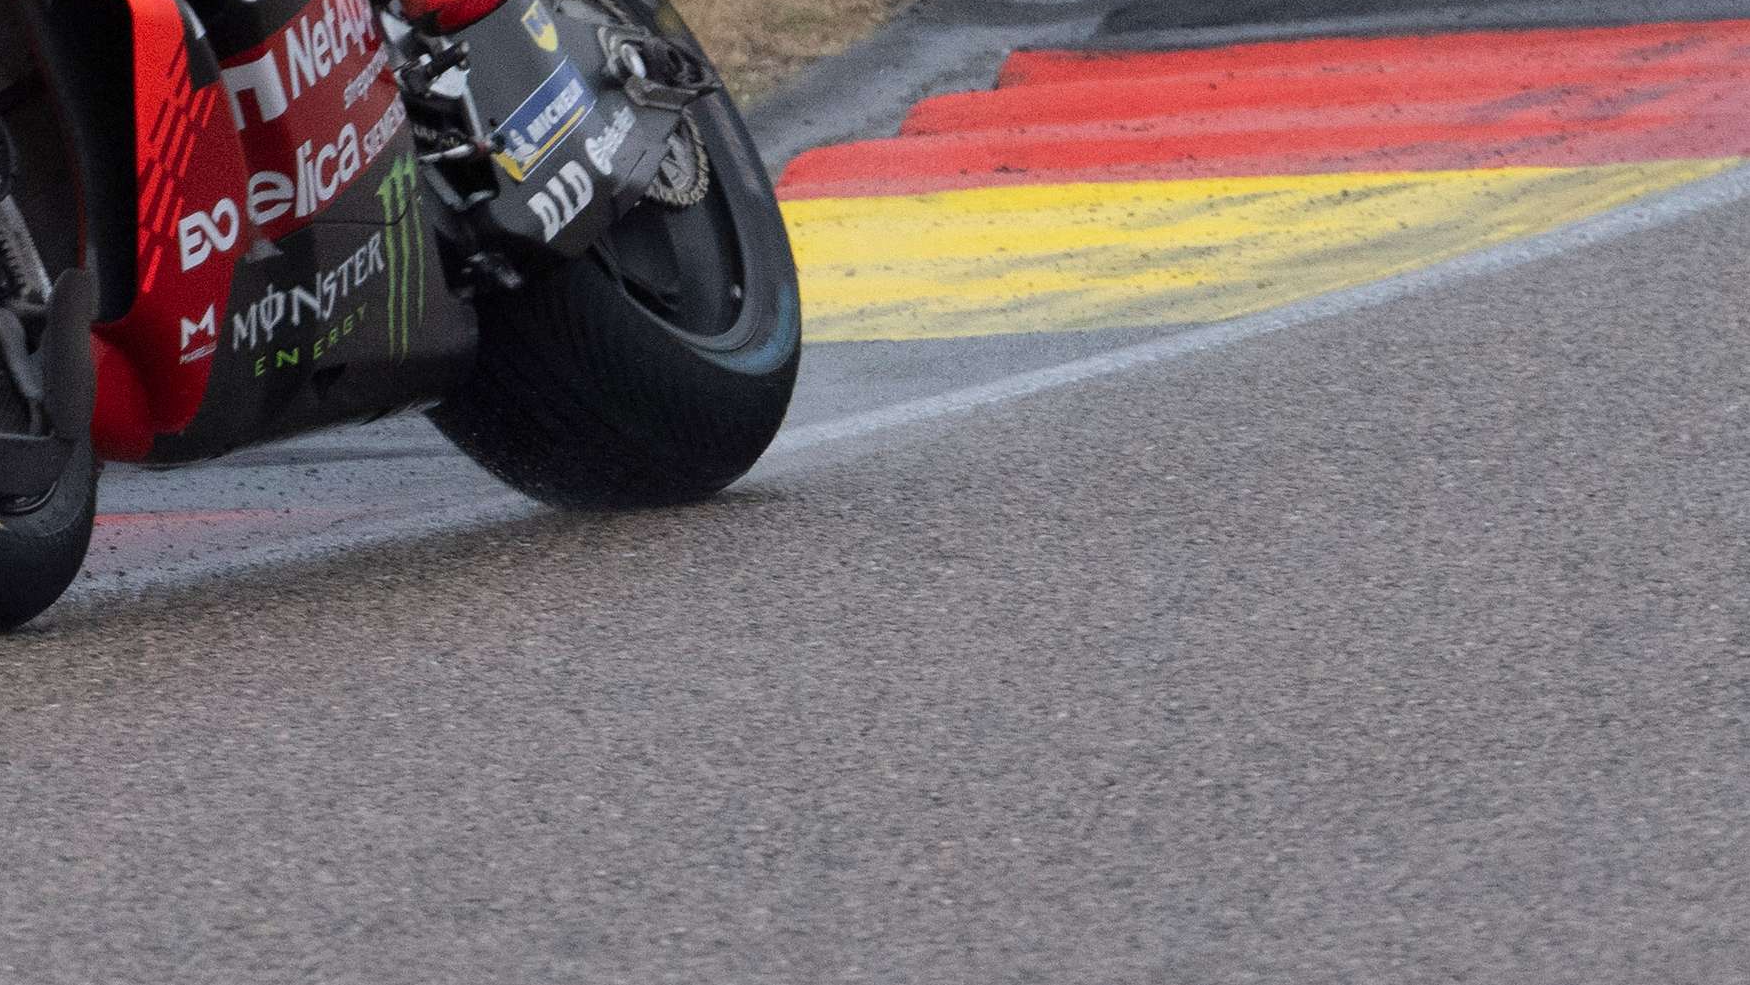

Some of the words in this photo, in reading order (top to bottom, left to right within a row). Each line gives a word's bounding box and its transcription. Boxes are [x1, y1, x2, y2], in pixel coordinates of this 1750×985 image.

[246, 123, 362, 227] elica
[527, 160, 593, 243] DID
[232, 230, 387, 352] MONSTER
